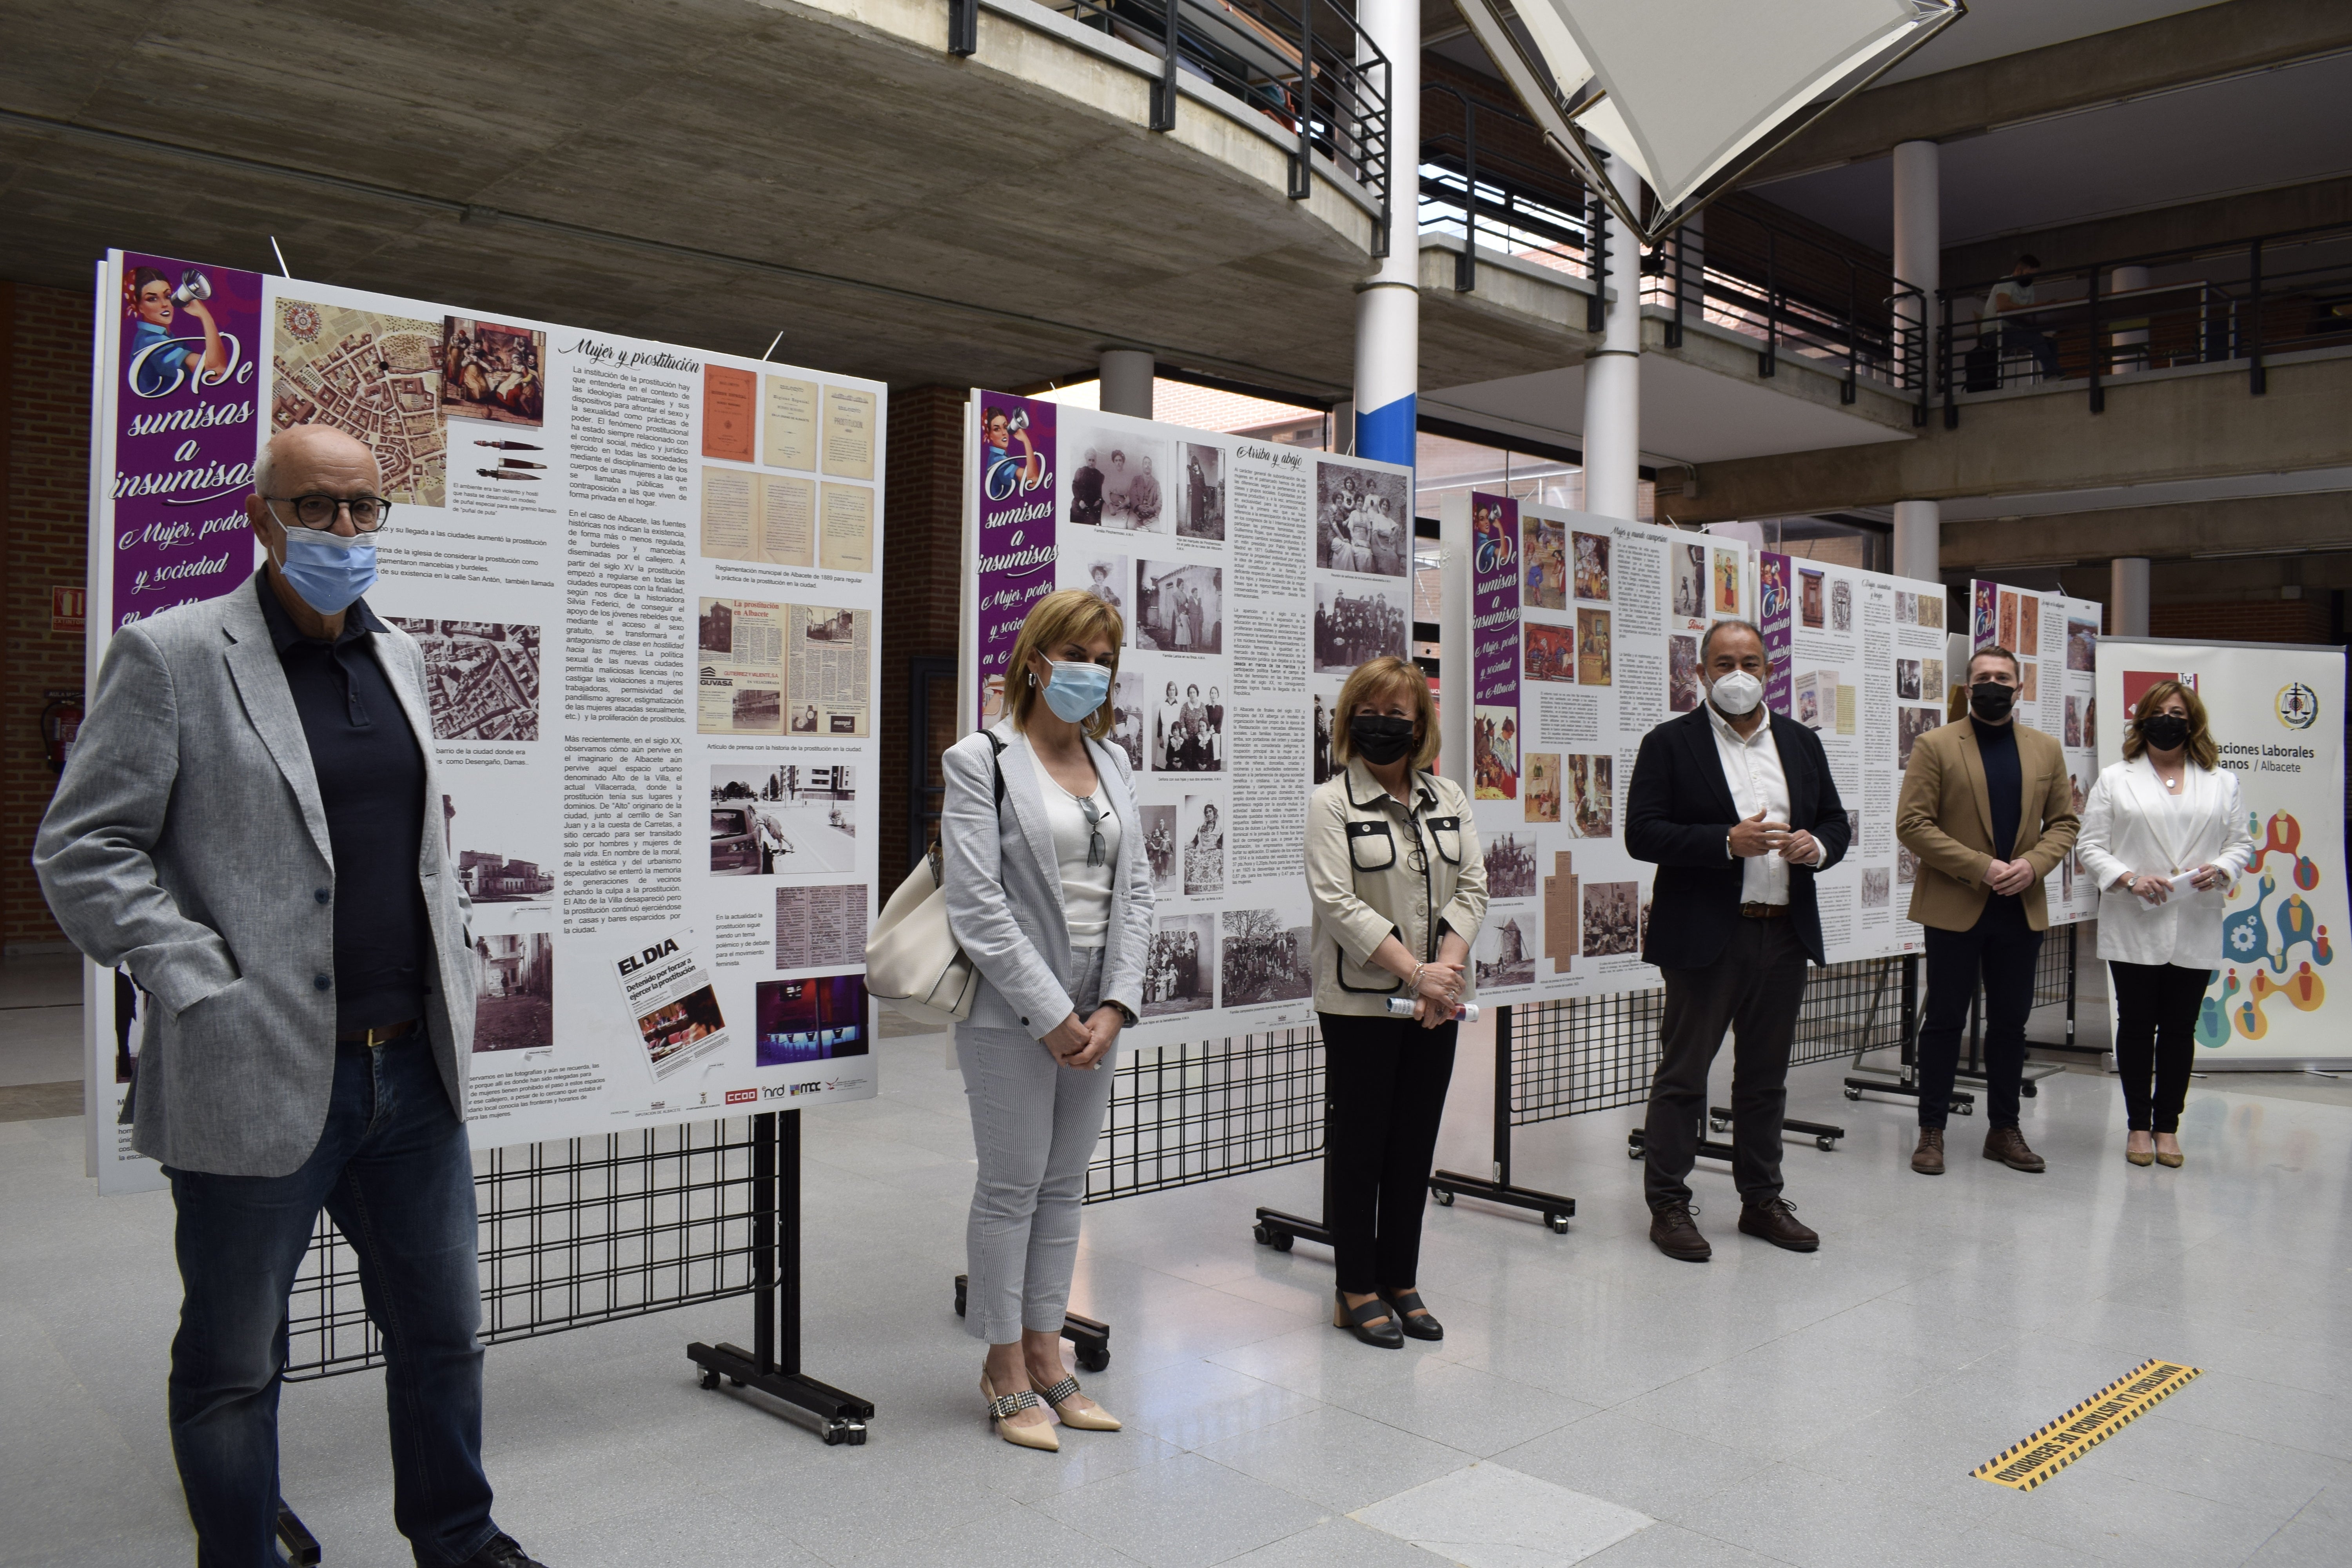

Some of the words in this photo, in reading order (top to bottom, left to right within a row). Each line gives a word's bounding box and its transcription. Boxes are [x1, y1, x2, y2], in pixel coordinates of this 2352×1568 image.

[129, 332, 253, 398] De
[558, 338, 615, 366] Mujer
[615, 351, 637, 370] y
[631, 352, 700, 373] prostitución
[572, 365, 582, 374] La
[583, 367, 618, 379] institución
[638, 377, 677, 389] prostitución
[678, 382, 691, 392] hay
[589, 379, 626, 390] entenderla
[650, 389, 679, 398] contexto
[128, 401, 254, 436] sumisas
[175, 440, 200, 461] a
[1237, 445, 1270, 461] Arriba
[1271, 454, 1284, 469] y
[1281, 452, 1304, 472] abajo
[109, 460, 256, 501] insumisas
[985, 451, 1053, 501] De
[199, 510, 251, 540] poder
[985, 501, 1054, 529] sumisas
[1011, 530, 1025, 546] a
[1610, 526, 1626, 539] Mujer
[975, 543, 1059, 575] insumisas
[1475, 535, 1517, 574] De
[131, 570, 165, 594] y
[154, 552, 229, 581] sociedad
[715, 564, 757, 574] Reglamentación
[1024, 580, 1053, 602] poder
[1476, 573, 1518, 595] sumisas
[1492, 596, 1501, 609] a
[1762, 586, 1790, 618] De
[122, 611, 141, 625] en
[988, 624, 1007, 642] y
[1000, 617, 1024, 633] socie
[1472, 605, 1522, 631] insumisas
[1763, 616, 1790, 635] sumisas
[1501, 633, 1519, 650] poder
[1773, 635, 1779, 646] a
[983, 653, 993, 664] en
[1768, 643, 1792, 662] umisas
[1479, 669, 1491, 682] y
[1486, 658, 1512, 675] sociedad
[1476, 690, 1483, 699] en
[1486, 679, 1516, 699] Albacete
[2218, 742, 2259, 755] aciones
[2262, 744, 2314, 758] Laborales
[2261, 760, 2301, 773] Albacete
[715, 922, 746, 931] prostitución
[715, 941, 740, 949] polémico
[617, 955, 644, 976] EL
[642, 938, 680, 965] DIA
[626, 975, 656, 992] Detenido
[656, 969, 667, 979] por
[668, 960, 686, 973] forzar
[630, 986, 651, 1000] ejercer
[658, 965, 696, 988] prostitución
[727, 1091, 755, 1102] CCOO
[2124, 1365, 2183, 1395] MANTENGA
[2111, 1393, 2140, 1403] LA
[2065, 1401, 2128, 1435] DISTANCIA
[2051, 1432, 2081, 1445] DE
[1994, 1443, 2066, 1482] SEGURIDAD
